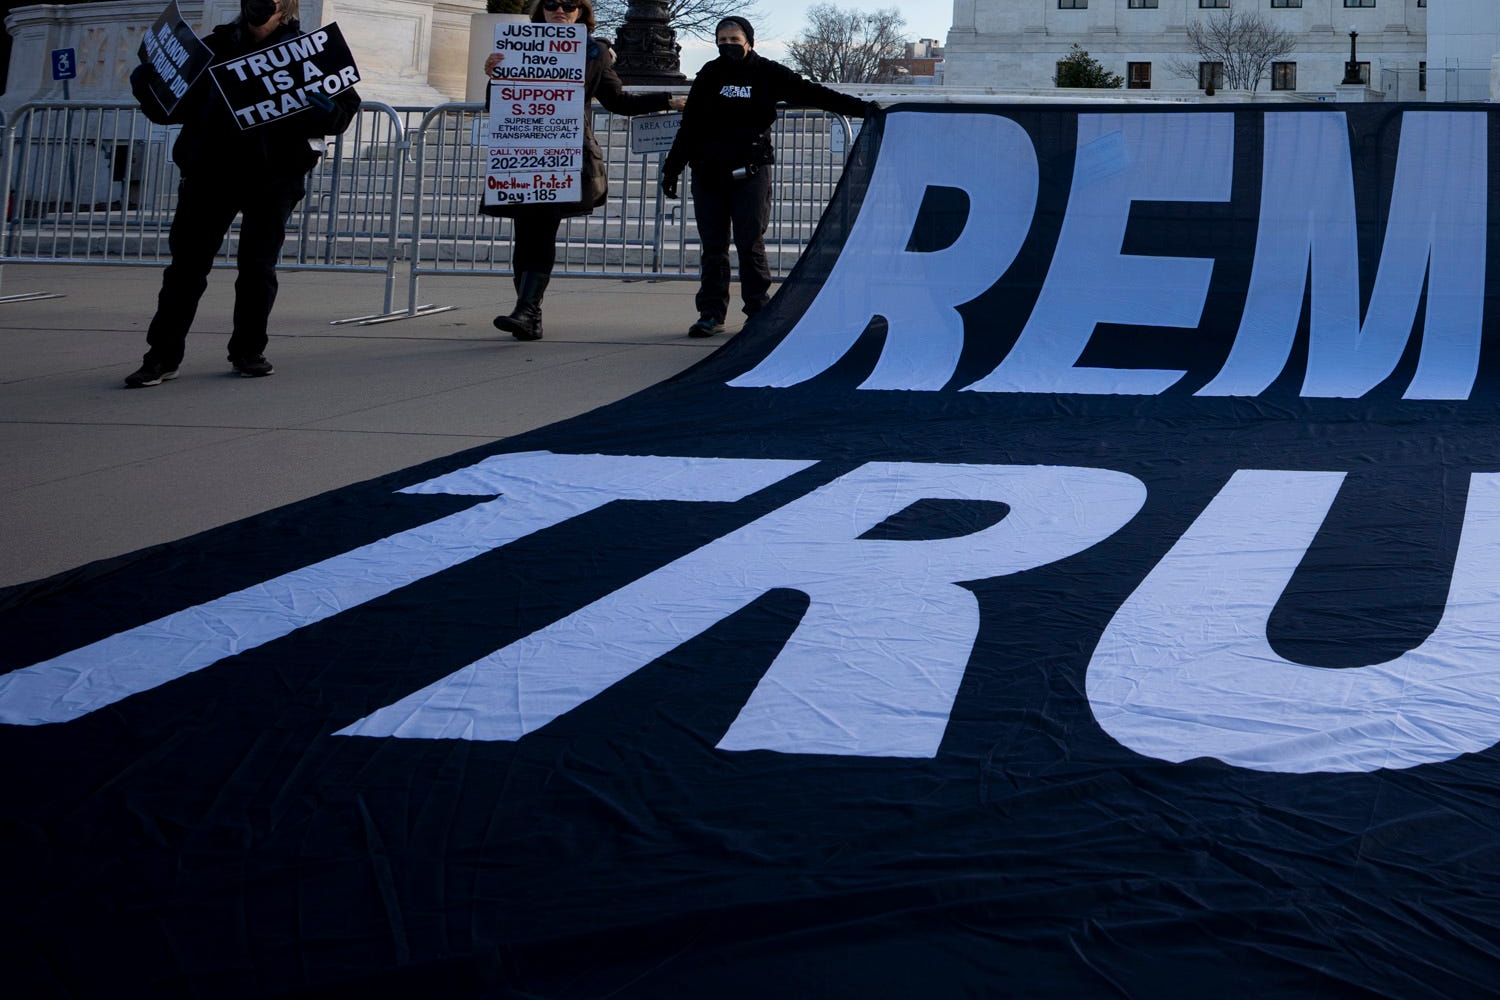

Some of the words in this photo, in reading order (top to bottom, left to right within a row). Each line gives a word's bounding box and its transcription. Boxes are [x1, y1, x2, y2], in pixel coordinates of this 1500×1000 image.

[503, 25, 576, 38] JUSTICES
[164, 34, 190, 68] KNOW
[496, 38, 544, 51] should
[549, 40, 581, 52] NOT
[226, 30, 328, 81] TRUMP
[522, 53, 558, 65] have
[151, 47, 177, 83] TRUMP
[170, 74, 189, 98] DID
[262, 70, 294, 95] IS
[303, 60, 323, 82] A
[492, 66, 582, 80] SUGARDADDIES
[501, 87, 575, 101] SUPPORT
[512, 103, 525, 115] S.
[528, 103, 555, 115] 359
[640, 121, 660, 130] AREA
[488, 175, 530, 189] One-Hour
[533, 174, 573, 189] Protest
[533, 189, 556, 201] 185
